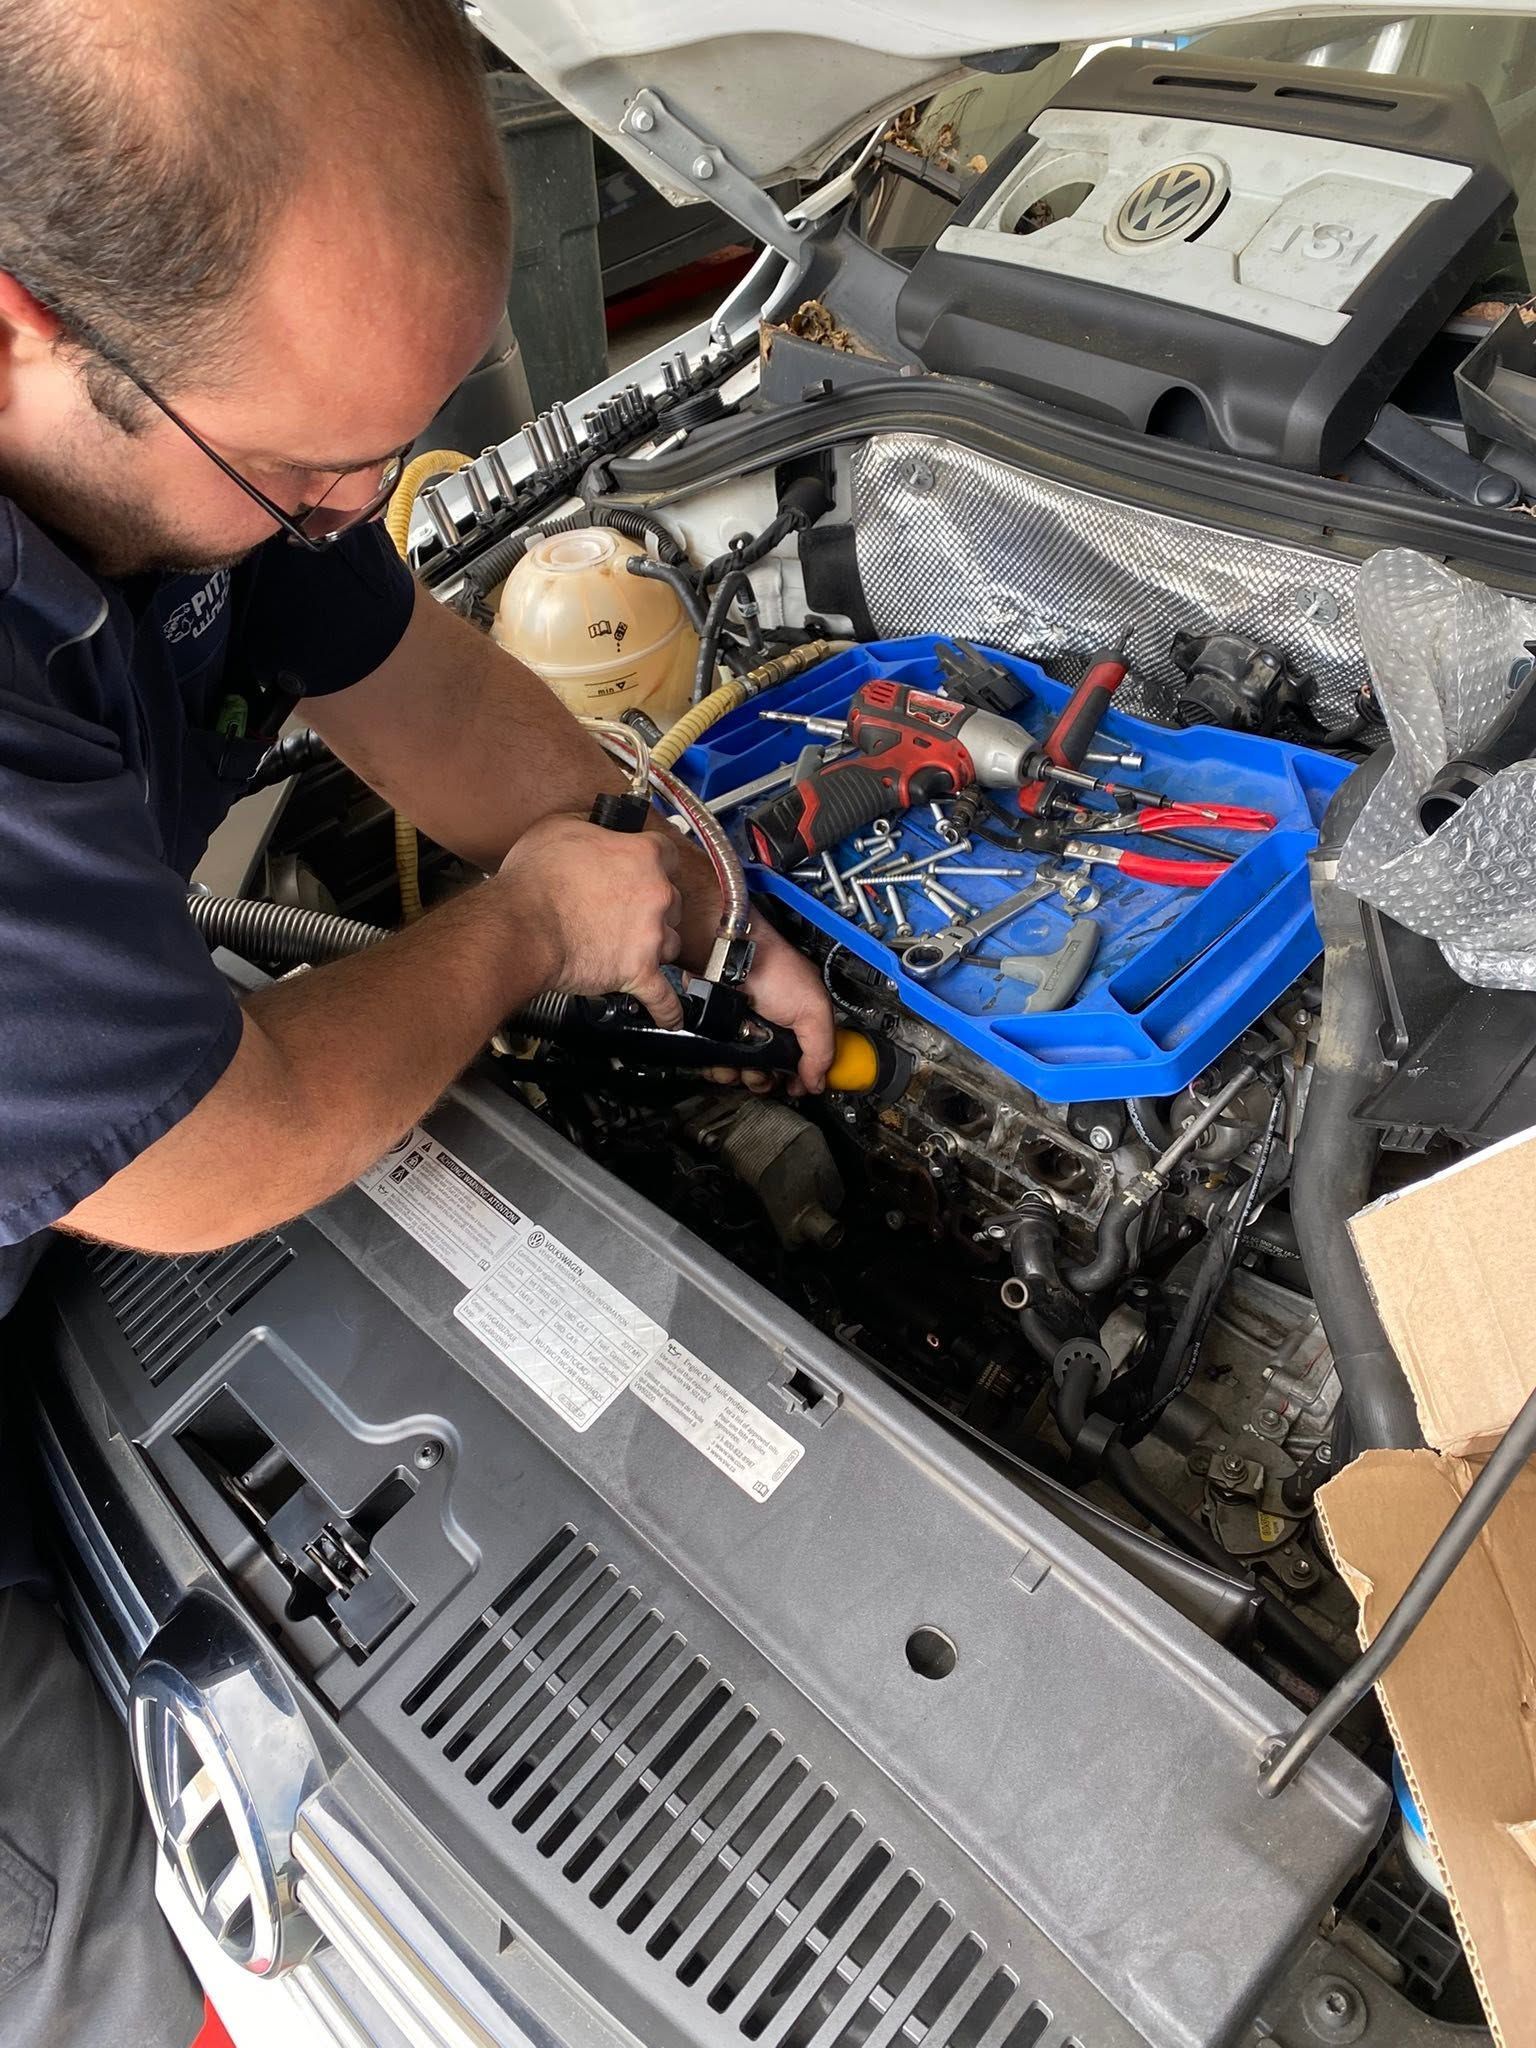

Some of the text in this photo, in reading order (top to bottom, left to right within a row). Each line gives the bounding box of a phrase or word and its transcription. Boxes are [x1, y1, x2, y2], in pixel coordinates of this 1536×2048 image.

[1269, 222, 1378, 266] TSI
[597, 687, 615, 696] min
[461, 1173, 491, 1200] WARNING!
[485, 1194, 519, 1224] ATTENTION!
[543, 1240, 585, 1277] VOLKSWAGEN
[573, 1278, 598, 1300] CONTROL
[594, 1295, 630, 1327] INFORMATION
[681, 1357, 712, 1383] Engine Oil
[681, 1371, 693, 1382] that
[690, 1379, 713, 1399] expressly
[681, 1381, 692, 1391] VW
[712, 1382, 749, 1415] Huile moteur
[740, 1421, 750, 1430] of
[745, 1425, 770, 1448] approved
[713, 1442, 746, 1472] www.vw.com
